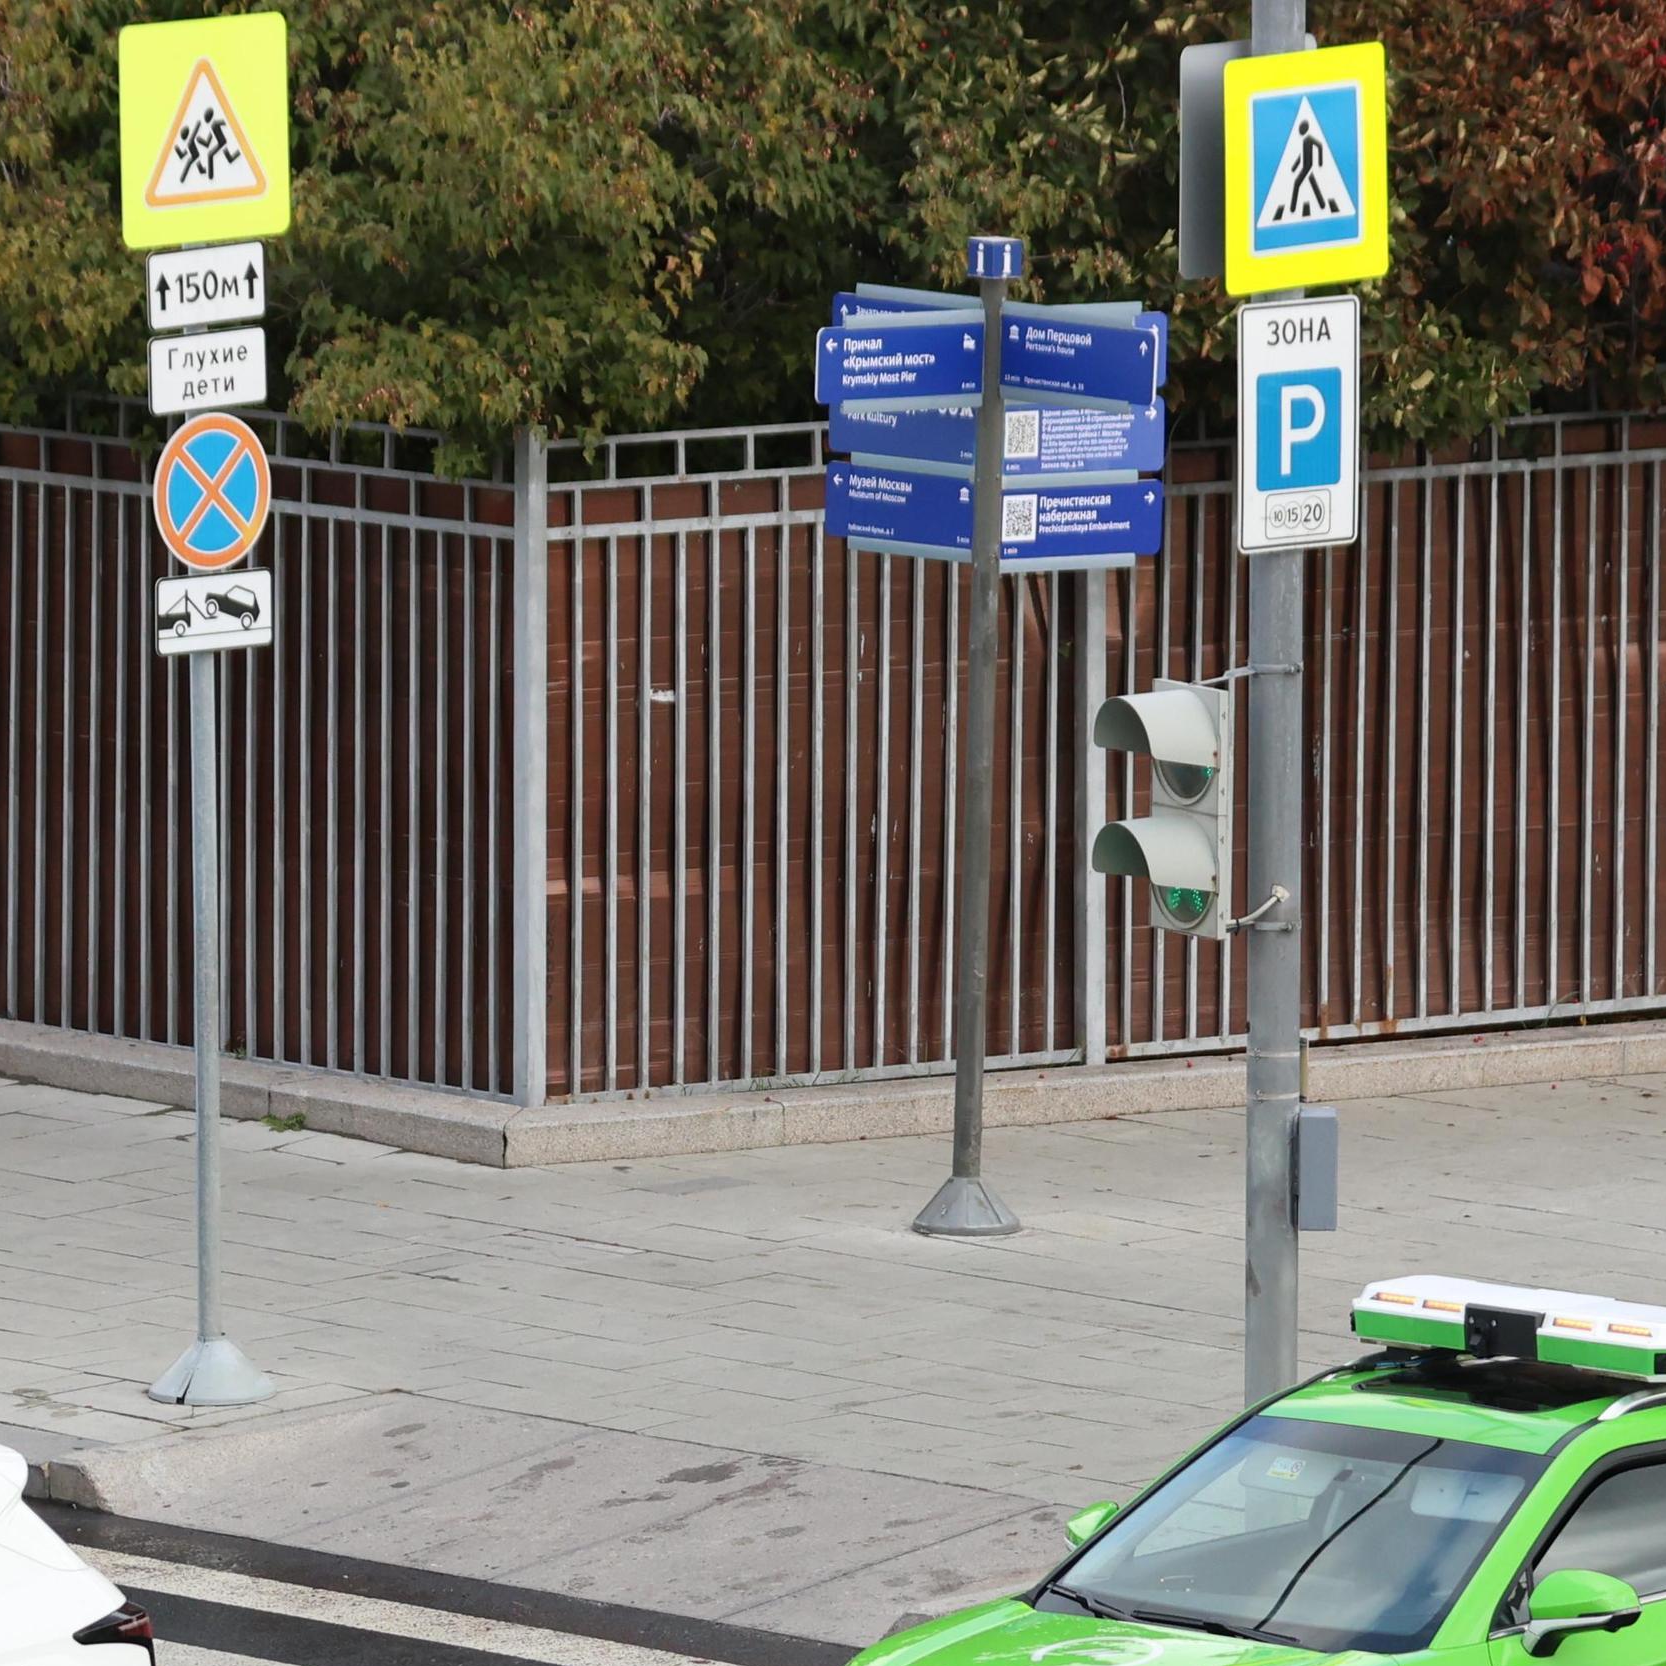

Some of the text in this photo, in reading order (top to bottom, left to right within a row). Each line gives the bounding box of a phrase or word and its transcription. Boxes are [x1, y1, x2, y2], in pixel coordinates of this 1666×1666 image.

[175, 269, 239, 304] 150м
[1025, 326, 1092, 347] Дом Перцовой
[1266, 316, 1332, 346] ЗОНА
[843, 338, 882, 353] Причал
[167, 345, 248, 372] Глухие
[843, 353, 935, 371] «Крымский мост»
[182, 376, 235, 401] дети
[842, 371, 917, 387] Krymskiy Most Pier
[867, 412, 898, 427] Kultury
[849, 474, 912, 493] Музей Москвы
[1039, 494, 1111, 510] Пречистенская
[1039, 510, 1097, 524] набережная
[1287, 507, 1299, 523] 15
[1303, 502, 1322, 523] 20
